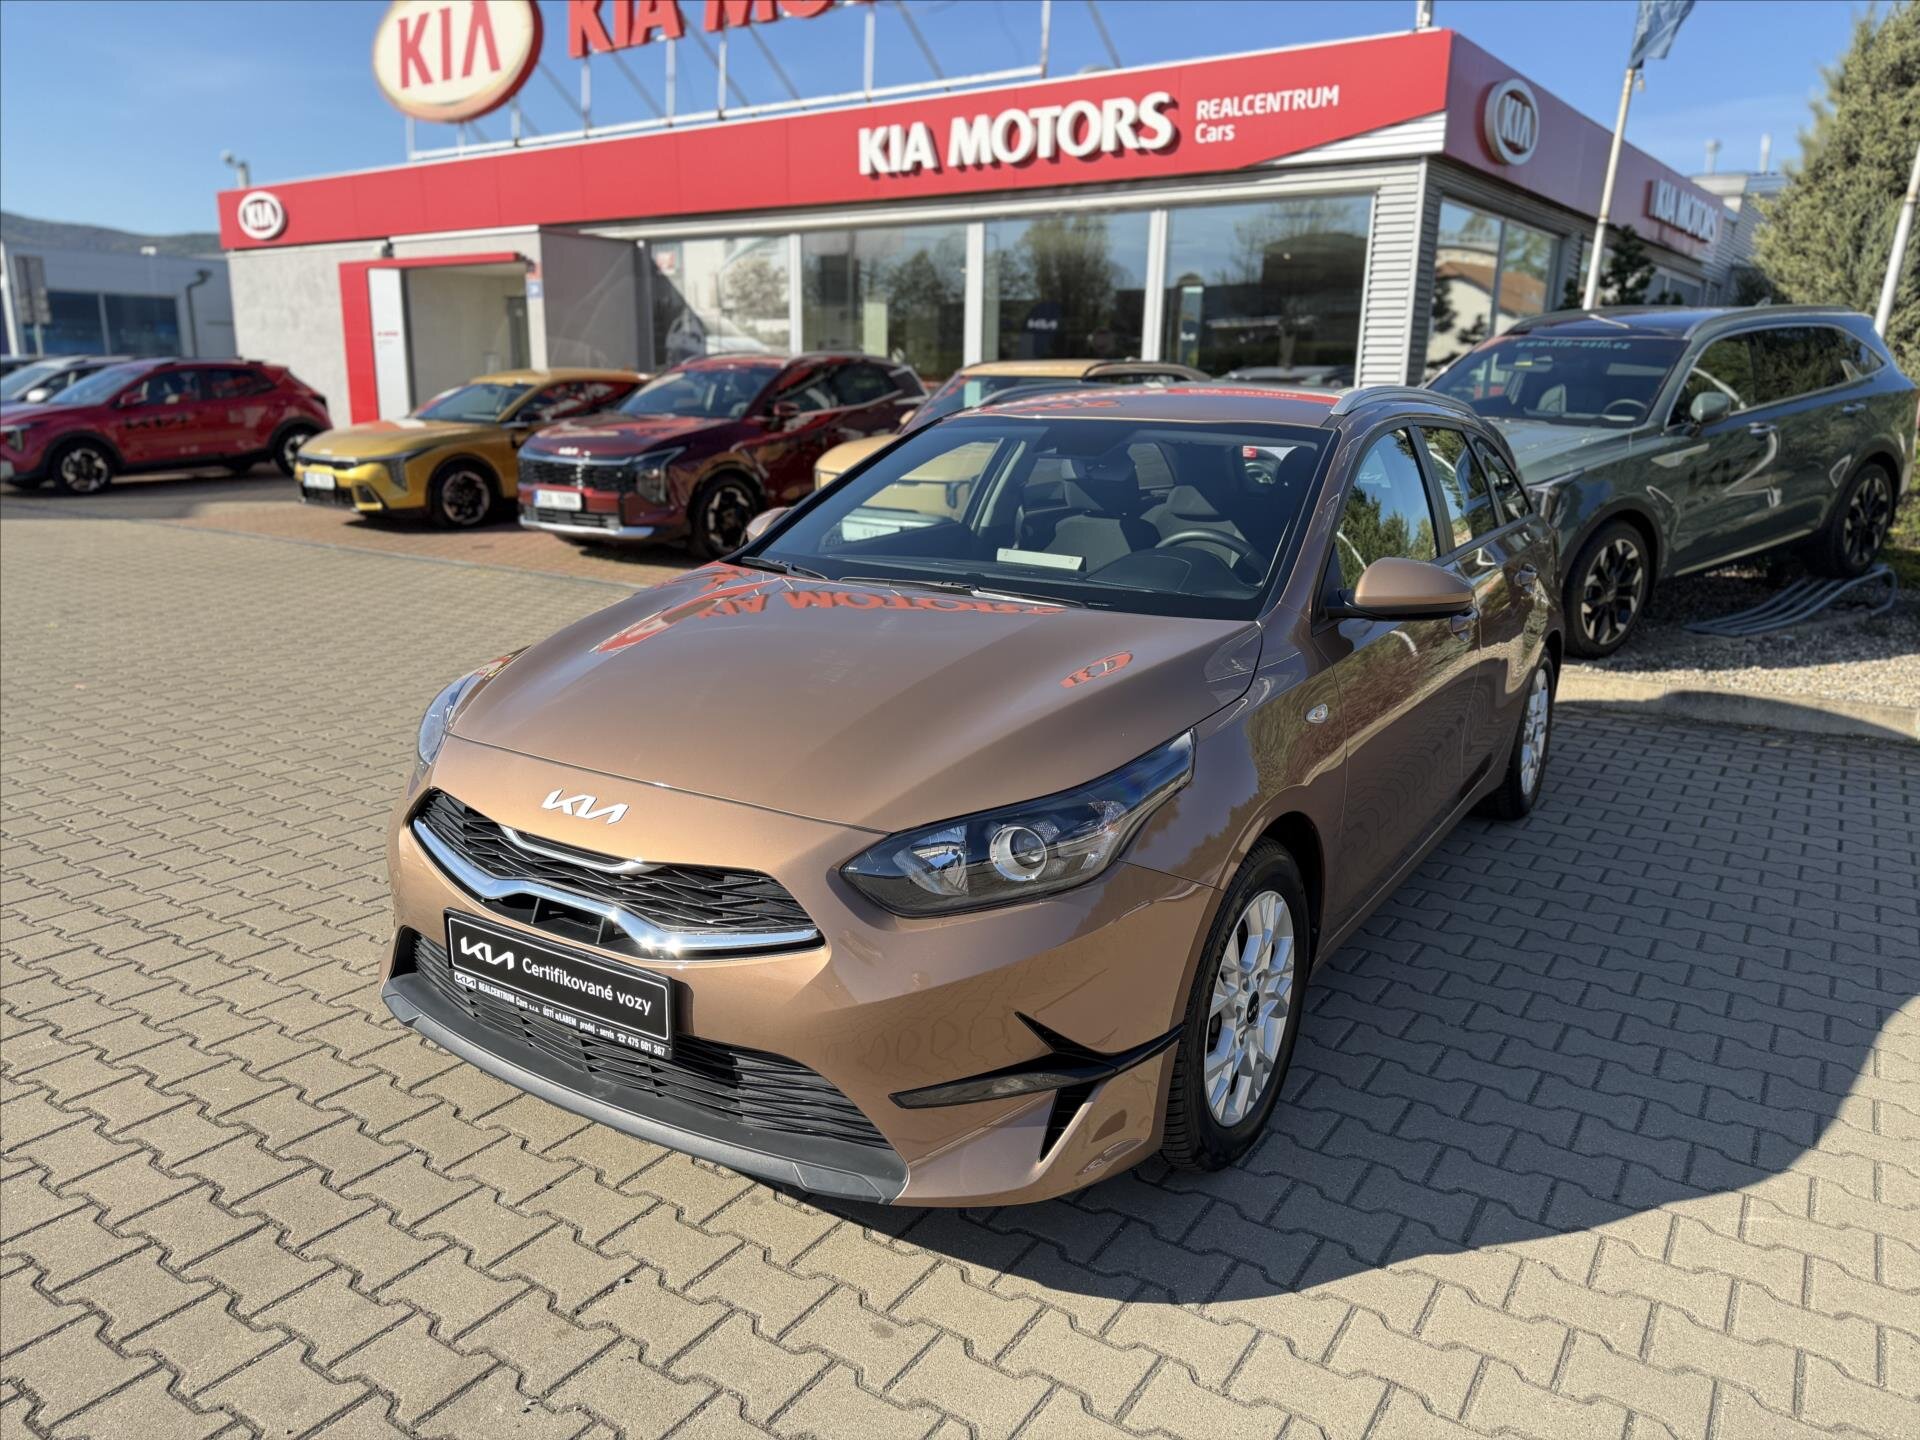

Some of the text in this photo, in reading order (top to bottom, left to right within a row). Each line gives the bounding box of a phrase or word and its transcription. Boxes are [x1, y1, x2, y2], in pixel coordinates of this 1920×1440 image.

[398, 0, 500, 90] KIA
[1195, 85, 1339, 121] REALCENTRUM
[1501, 93, 1533, 149] KIA
[859, 91, 1176, 175] KIA MOTORS
[1195, 122, 1235, 144] Cars
[245, 203, 277, 229] KIA
[1650, 181, 1718, 243] KIA MOTORS
[541, 787, 629, 824] KIA
[460, 936, 652, 1016] KIA Certifikované vozy
[515, 996, 528, 1009] Cars
[579, 1021, 596, 1034] prodej
[599, 1028, 615, 1040] servis
[627, 1036, 640, 1048] 475
[640, 1040, 652, 1052] 601
